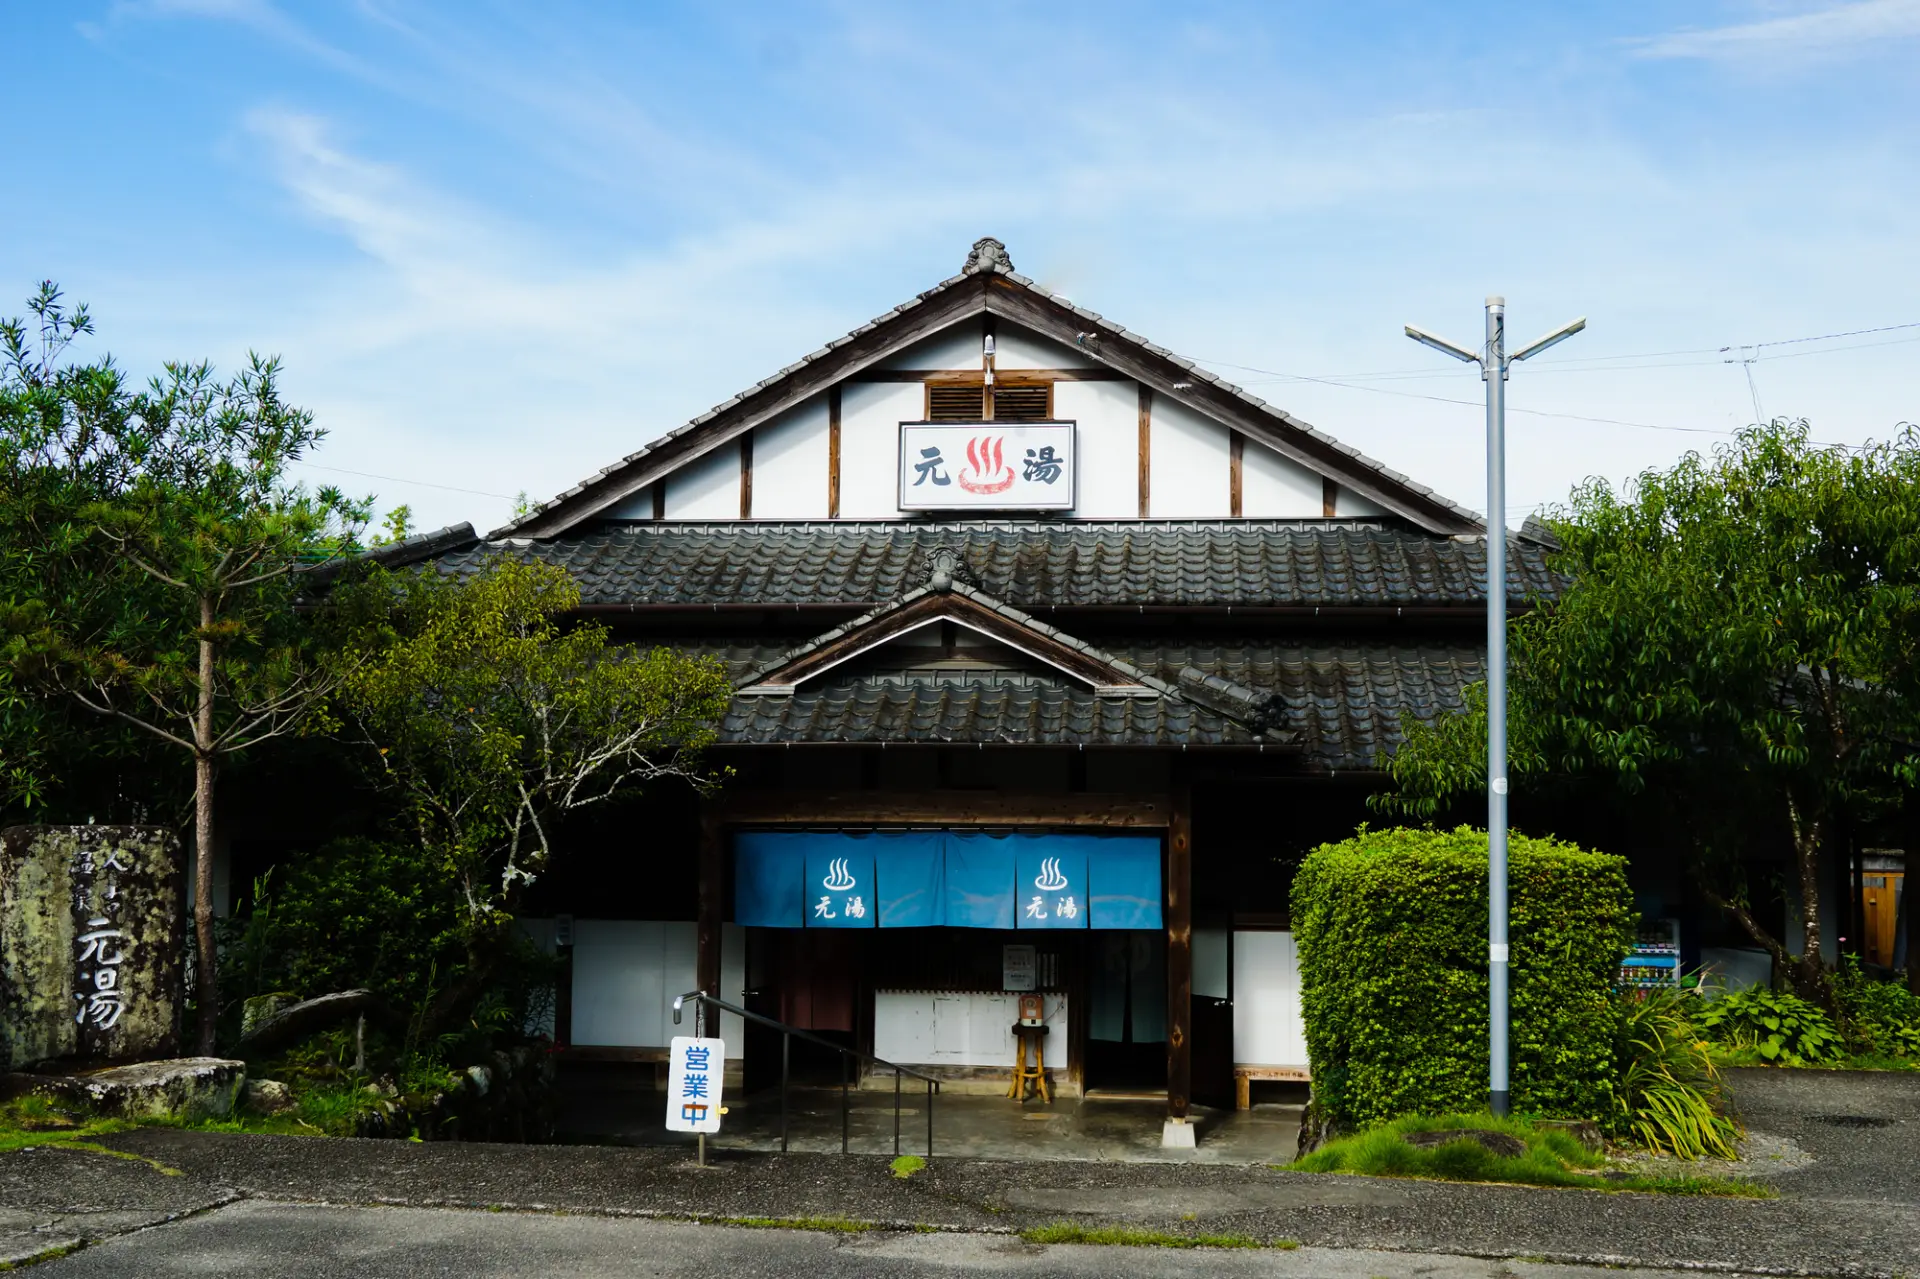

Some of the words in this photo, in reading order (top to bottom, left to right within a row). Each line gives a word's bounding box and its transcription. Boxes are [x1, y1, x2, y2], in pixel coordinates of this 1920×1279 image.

[76, 917, 125, 1031] 元湯
[681, 1045, 710, 1126] 営業中
